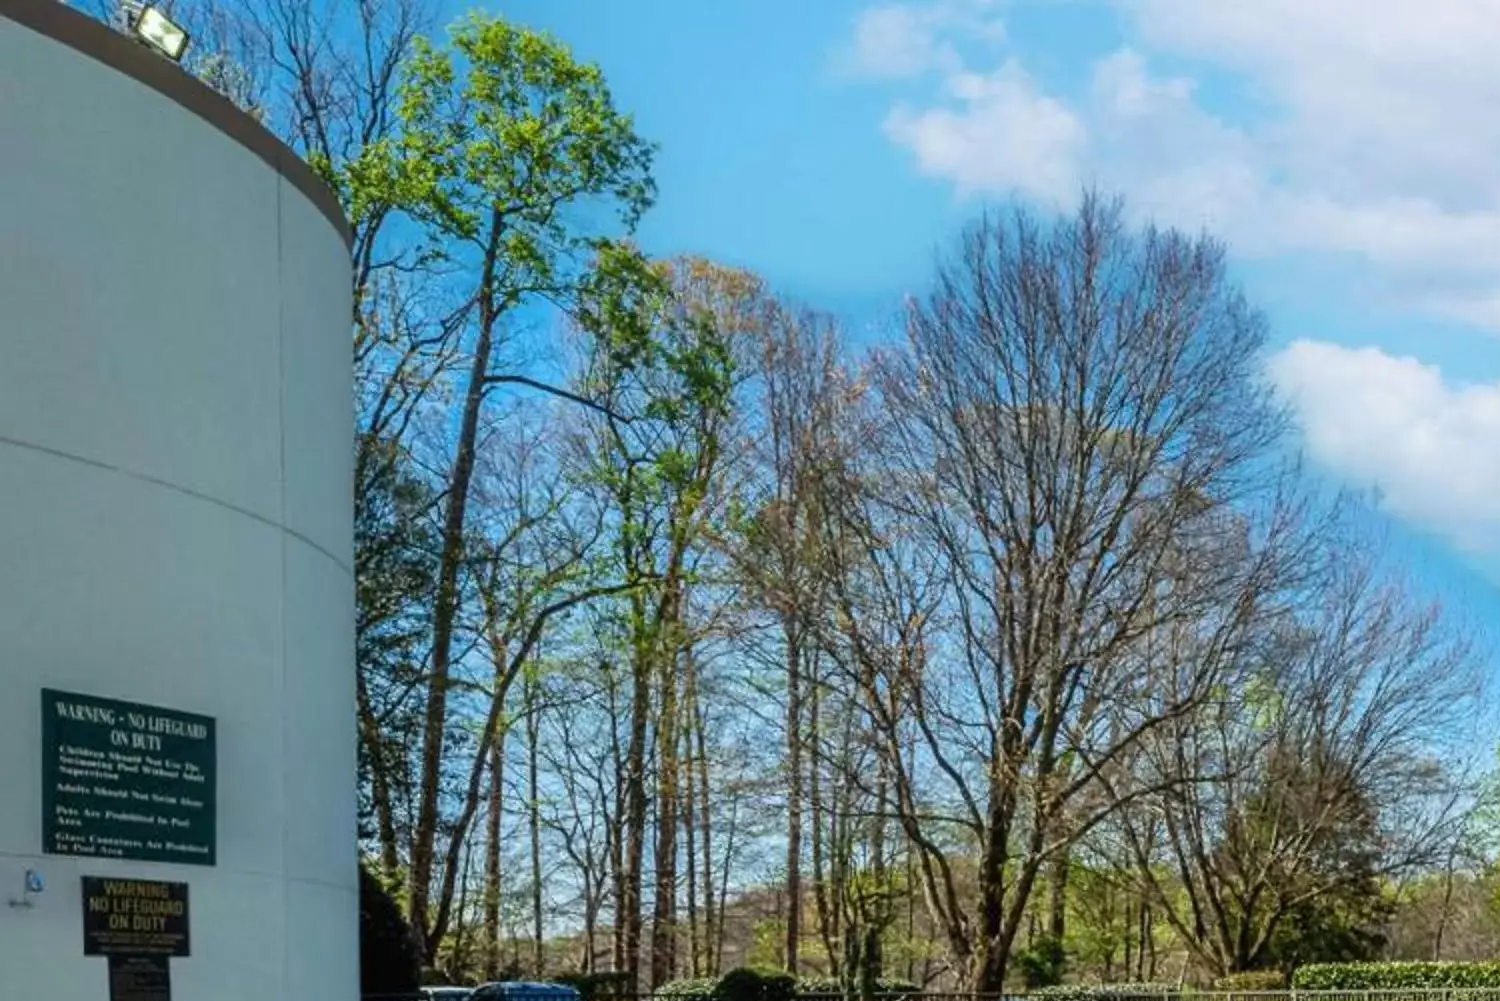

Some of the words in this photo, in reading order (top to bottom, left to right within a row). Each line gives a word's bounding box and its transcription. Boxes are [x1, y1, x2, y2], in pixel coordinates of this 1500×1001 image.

[56, 701, 115, 726] WARNING
[128, 712, 146, 730] NO
[148, 715, 207, 740] LIFEGUARD
[110, 728, 129, 746] ON
[132, 732, 161, 751] DUTY
[59, 744, 105, 759] Children
[108, 751, 142, 763] Should
[145, 755, 162, 767] Not
[165, 758, 181, 769] Use
[184, 760, 199, 772] The
[59, 755, 113, 771] Swimming
[117, 762, 139, 773] Pool
[141, 765, 179, 778] Without
[182, 772, 205, 783] Adult
[58, 765, 119, 781] Supervision
[57, 782, 90, 796] Adults
[93, 786, 129, 799] Should
[131, 789, 149, 801] Not
[151, 793, 177, 805] Swim
[56, 804, 79, 816] Pets
[84, 807, 101, 819] Are
[171, 817, 191, 828] Pool
[104, 880, 169, 898] WARNING
[89, 895, 109, 913] NO
[113, 898, 183, 916] LIFEGUARD
[109, 914, 129, 929] ON
[133, 915, 166, 931] DUTY
